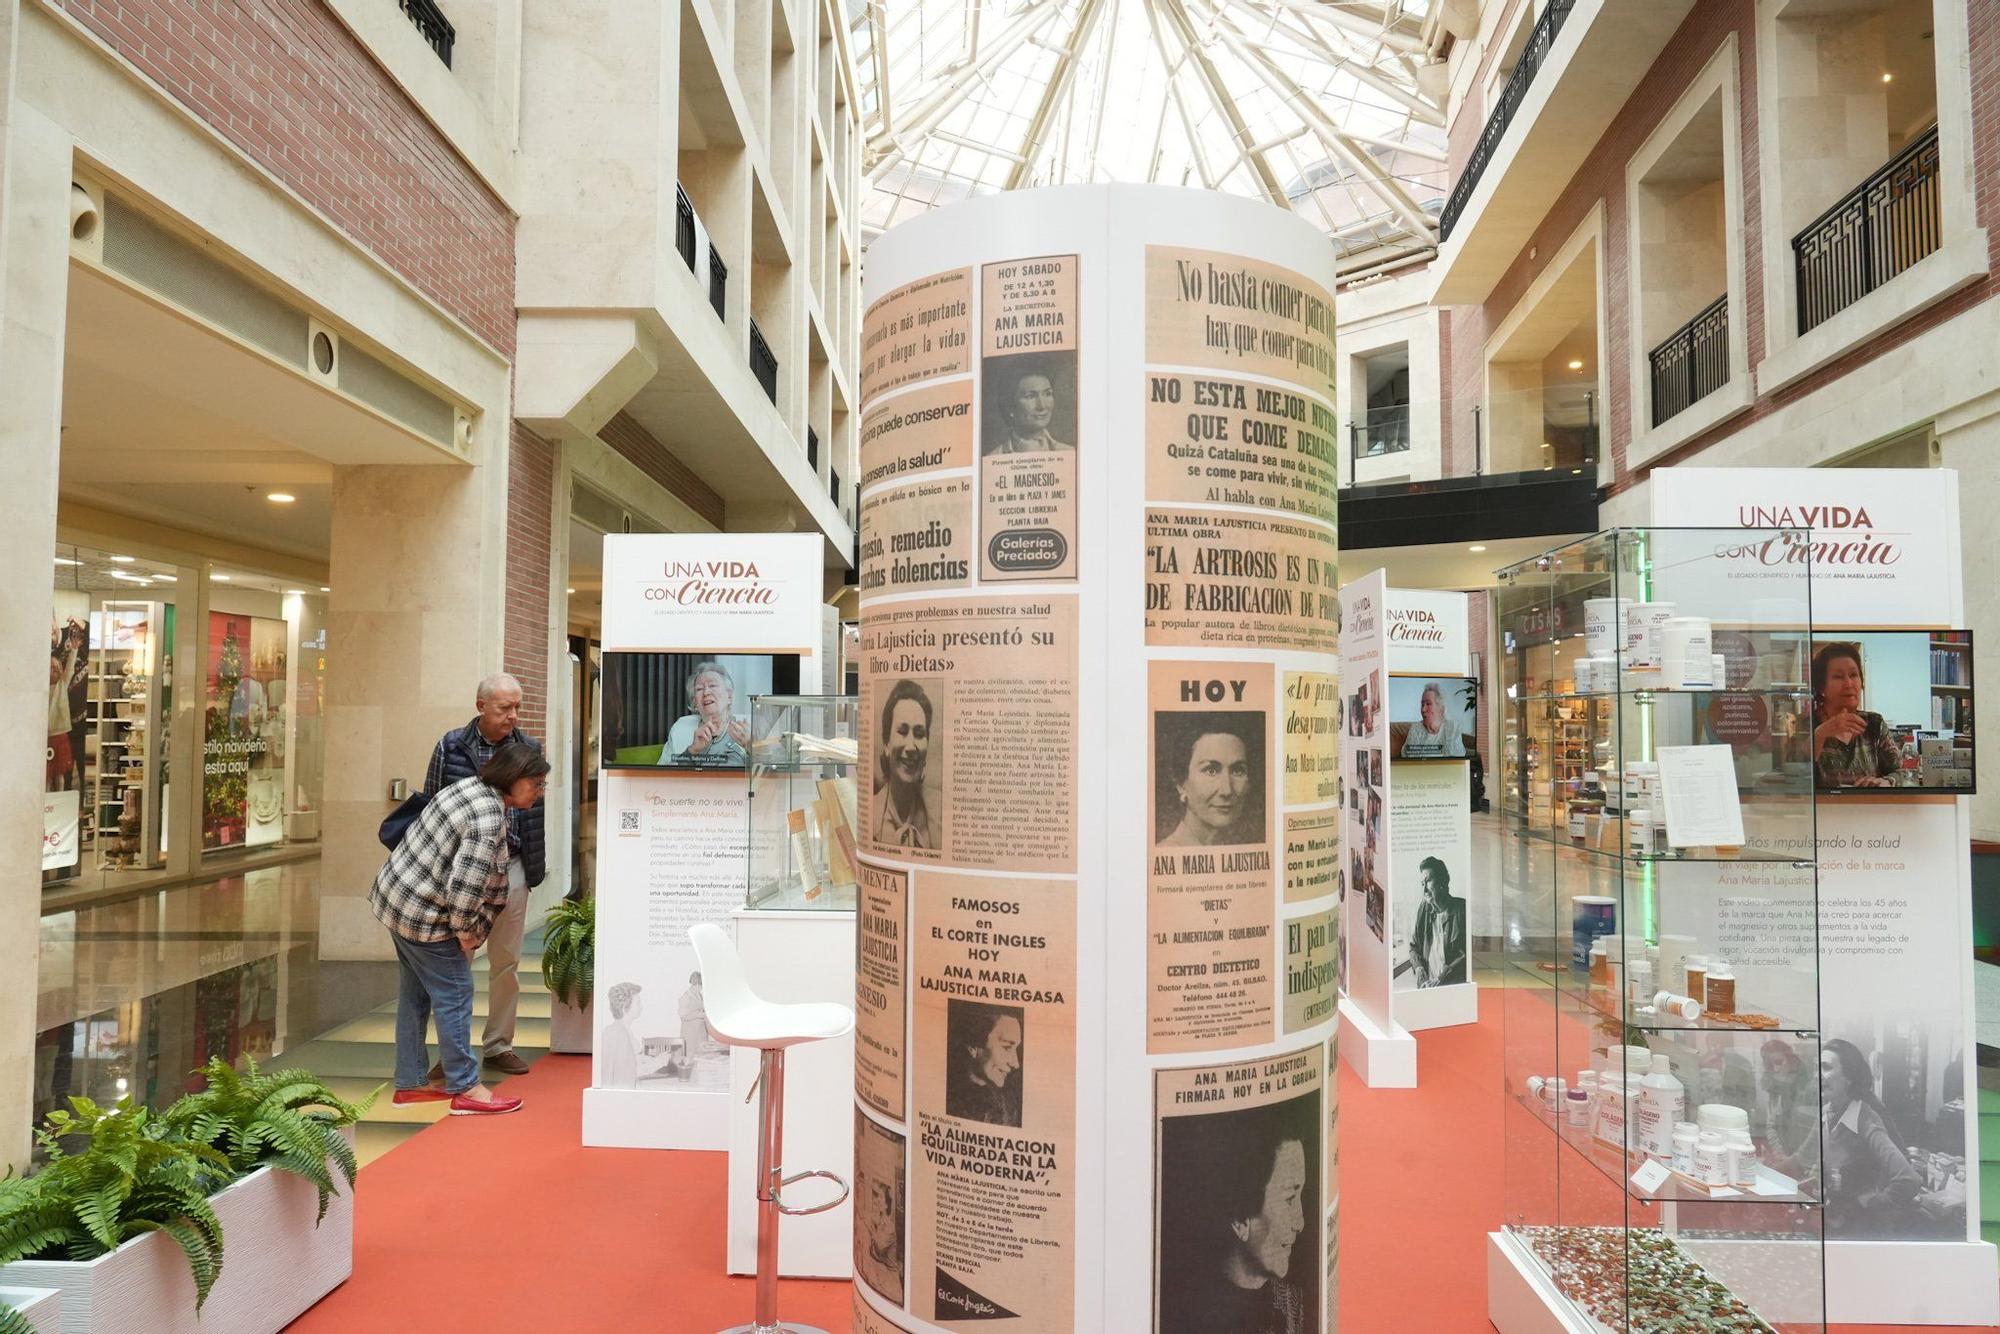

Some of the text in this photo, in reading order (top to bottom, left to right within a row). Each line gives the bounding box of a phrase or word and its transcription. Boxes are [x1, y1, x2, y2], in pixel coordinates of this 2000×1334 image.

[998, 264, 1061, 279] HOY SABADO
[1176, 260, 1202, 302] No
[1208, 263, 1257, 311] basta
[1262, 279, 1303, 325] comer
[919, 300, 966, 327] importante
[995, 313, 1064, 331] ANA MARIA
[924, 334, 931, 353] la
[996, 331, 1063, 349] LAJUSTICIA
[1207, 315, 1295, 361] hay que comer
[1152, 378, 1181, 403] NO
[1194, 381, 1247, 410] ESTA
[1257, 389, 1306, 423] MEJOR
[877, 403, 970, 440] puede conservar
[1188, 414, 1287, 449] QUE COME
[898, 452, 907, 469] la
[1168, 444, 1295, 470] Quizá Cataluña sea una
[1188, 466, 1264, 486] se come para
[961, 482, 970, 491] la
[1207, 488, 1295, 511] Al habla con Ana
[1148, 515, 1307, 536] ANA MARIA LAJUSTICIA PRESENTO
[1740, 506, 1873, 528] UNA VIDA
[891, 521, 952, 553] remedio
[1148, 527, 1222, 539] ULTIMA OBRA
[1000, 538, 1054, 549] Galerías
[1760, 531, 1902, 566] Ciencia
[997, 550, 1057, 561] Preciados
[664, 561, 759, 578] UNA VIDA
[892, 554, 968, 583] dolencias
[1147, 546, 1319, 584] “LA ARTROSIS ES UN
[645, 580, 780, 605] CON Ciencia
[1146, 583, 1314, 617] DE FABRICACION DE
[916, 604, 1050, 622] problemas en nuestra salud
[1406, 610, 1435, 623] VIDA
[1162, 618, 1274, 631] popular autora de libros
[1390, 623, 1447, 642] Ciencia
[877, 627, 1054, 653] Lajusticia presentó su
[1201, 631, 1224, 641] dieta
[870, 655, 955, 673] libro «Dietas»
[1181, 680, 1247, 702] HOY
[204, 738, 267, 754] stilo navideño
[205, 758, 249, 775] está aquí
[654, 796, 666, 805] De
[1288, 842, 1304, 853] Ana
[1851, 836, 1901, 848] la salud
[1154, 851, 1270, 875] ANA MARIA LAJUSTICIA
[1288, 861, 1303, 870] con
[1762, 863, 1778, 874] por
[1846, 861, 1905, 871] de la marca
[1718, 876, 1738, 885] Ana
[952, 898, 1020, 914] FAMOSOS
[1828, 899, 1858, 907] celebra
[1888, 899, 1907, 907] años
[976, 919, 992, 929] en
[1768, 912, 1784, 921] que
[1852, 912, 1870, 921] para
[875, 915, 898, 940] MARIA
[1729, 923, 1767, 932] magnesio
[1871, 923, 1887, 931] vida
[932, 927, 1046, 948] EL CORTE INGLES
[1154, 930, 1223, 944] “LA ALIMENTACION
[1288, 923, 1325, 957] El pan
[1867, 935, 1896, 944] legado
[968, 949, 999, 962] HOY
[944, 965, 1027, 985] ANA MARIA
[1167, 959, 1259, 976] CENTRO DIETETICO
[1288, 960, 1338, 995] indispens
[921, 977, 1064, 1003] LAJUSTICIA BERGASA
[1157, 984, 1181, 992] Doctor
[1183, 994, 1212, 1002] Teléfono
[1195, 1056, 1307, 1086] ANA MARIA LAJUSTICIA
[1176, 1078, 1287, 1103] FIRMARA HOY EN LA
[1601, 1112, 1624, 1122] COLAGEN
[946, 1128, 1055, 1155] ALIMENTACION
[922, 1134, 1056, 1170] EQUILIBRADA EN LA
[926, 1150, 955, 1168] VIDA
[956, 1256, 981, 1268] ESPECIAL
[938, 1289, 945, 1300] El
[946, 1291, 964, 1306] Corte
